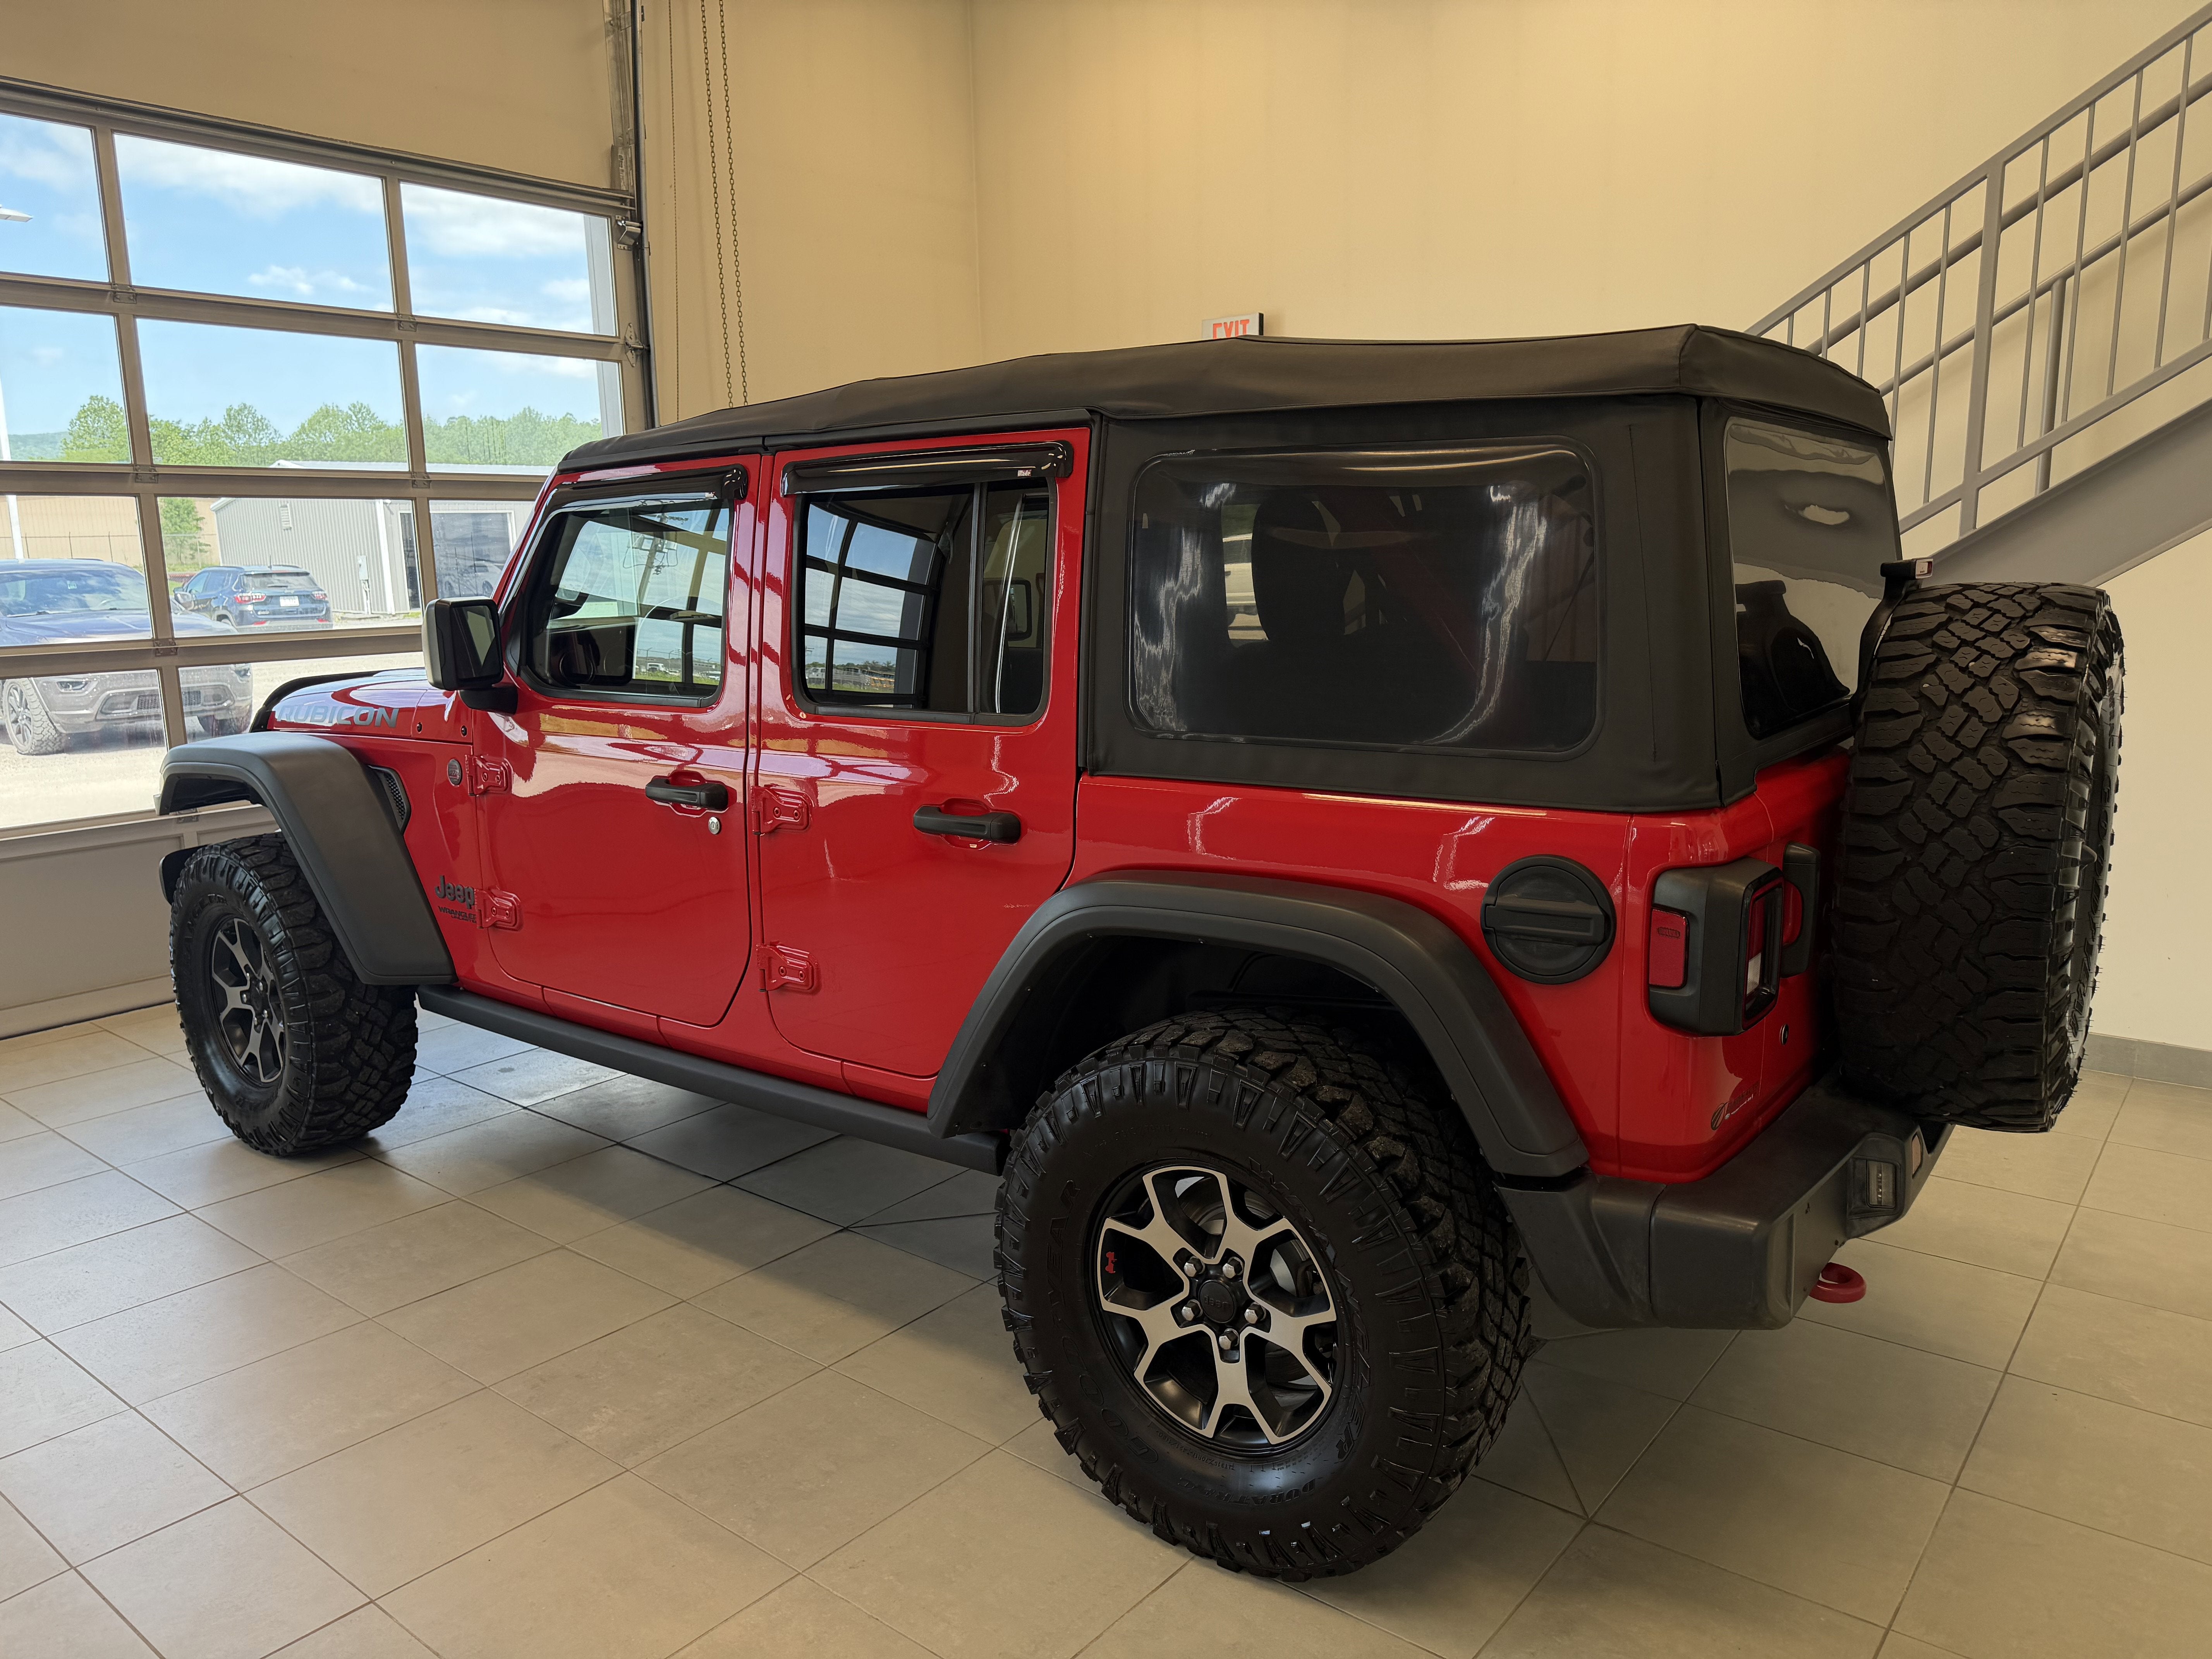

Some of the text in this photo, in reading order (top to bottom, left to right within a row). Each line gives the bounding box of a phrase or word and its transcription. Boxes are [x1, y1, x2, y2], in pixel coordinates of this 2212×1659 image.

[277, 705, 399, 728] RUBICON
[434, 874, 475, 910] Jeep
[1177, 1477, 1316, 1506] DURATRAC
